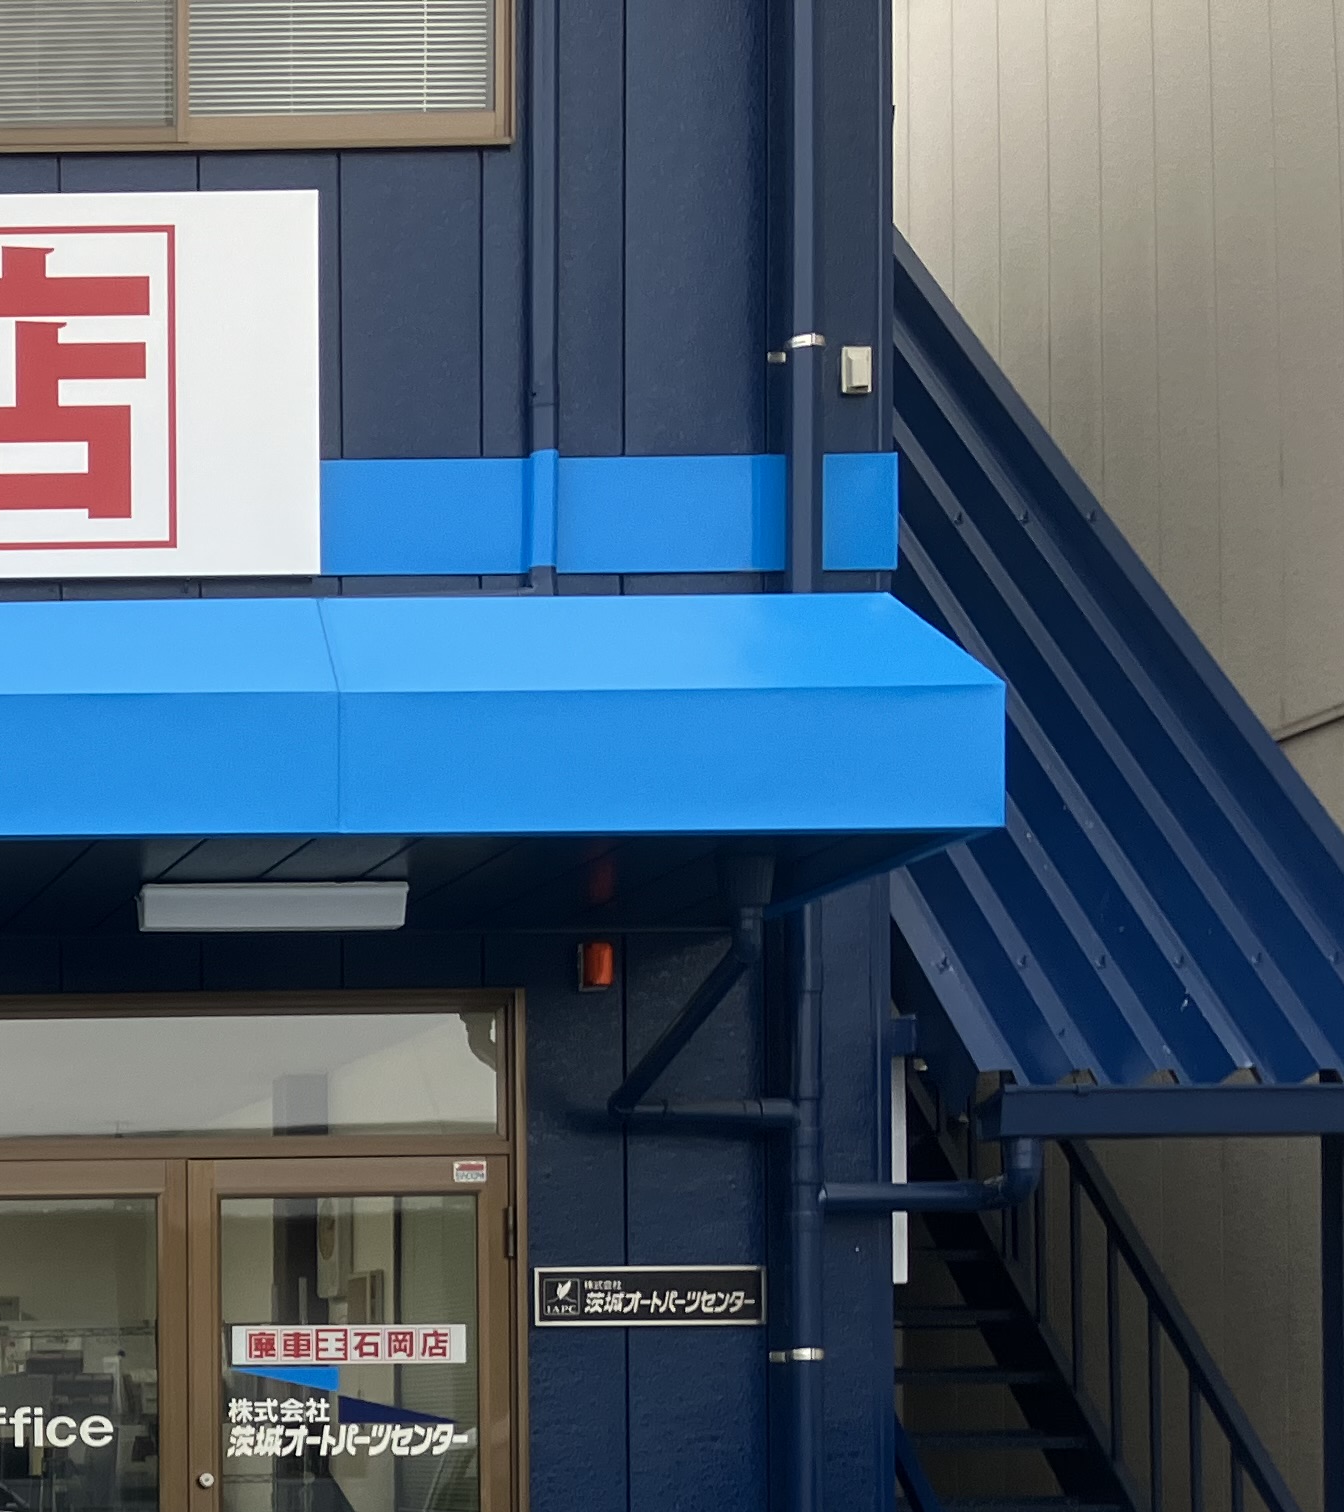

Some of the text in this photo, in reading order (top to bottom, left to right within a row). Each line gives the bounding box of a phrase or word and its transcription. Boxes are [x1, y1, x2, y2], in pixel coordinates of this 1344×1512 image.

[584, 1280, 622, 1290] 株式会社
[584, 1291, 755, 1314] 茨城オートパーツセンター
[248, 1328, 449, 1361] 廃車王石岡店
[228, 1398, 331, 1423] 株式会社
[227, 1423, 469, 1457] 茨城オートパーツセンター
